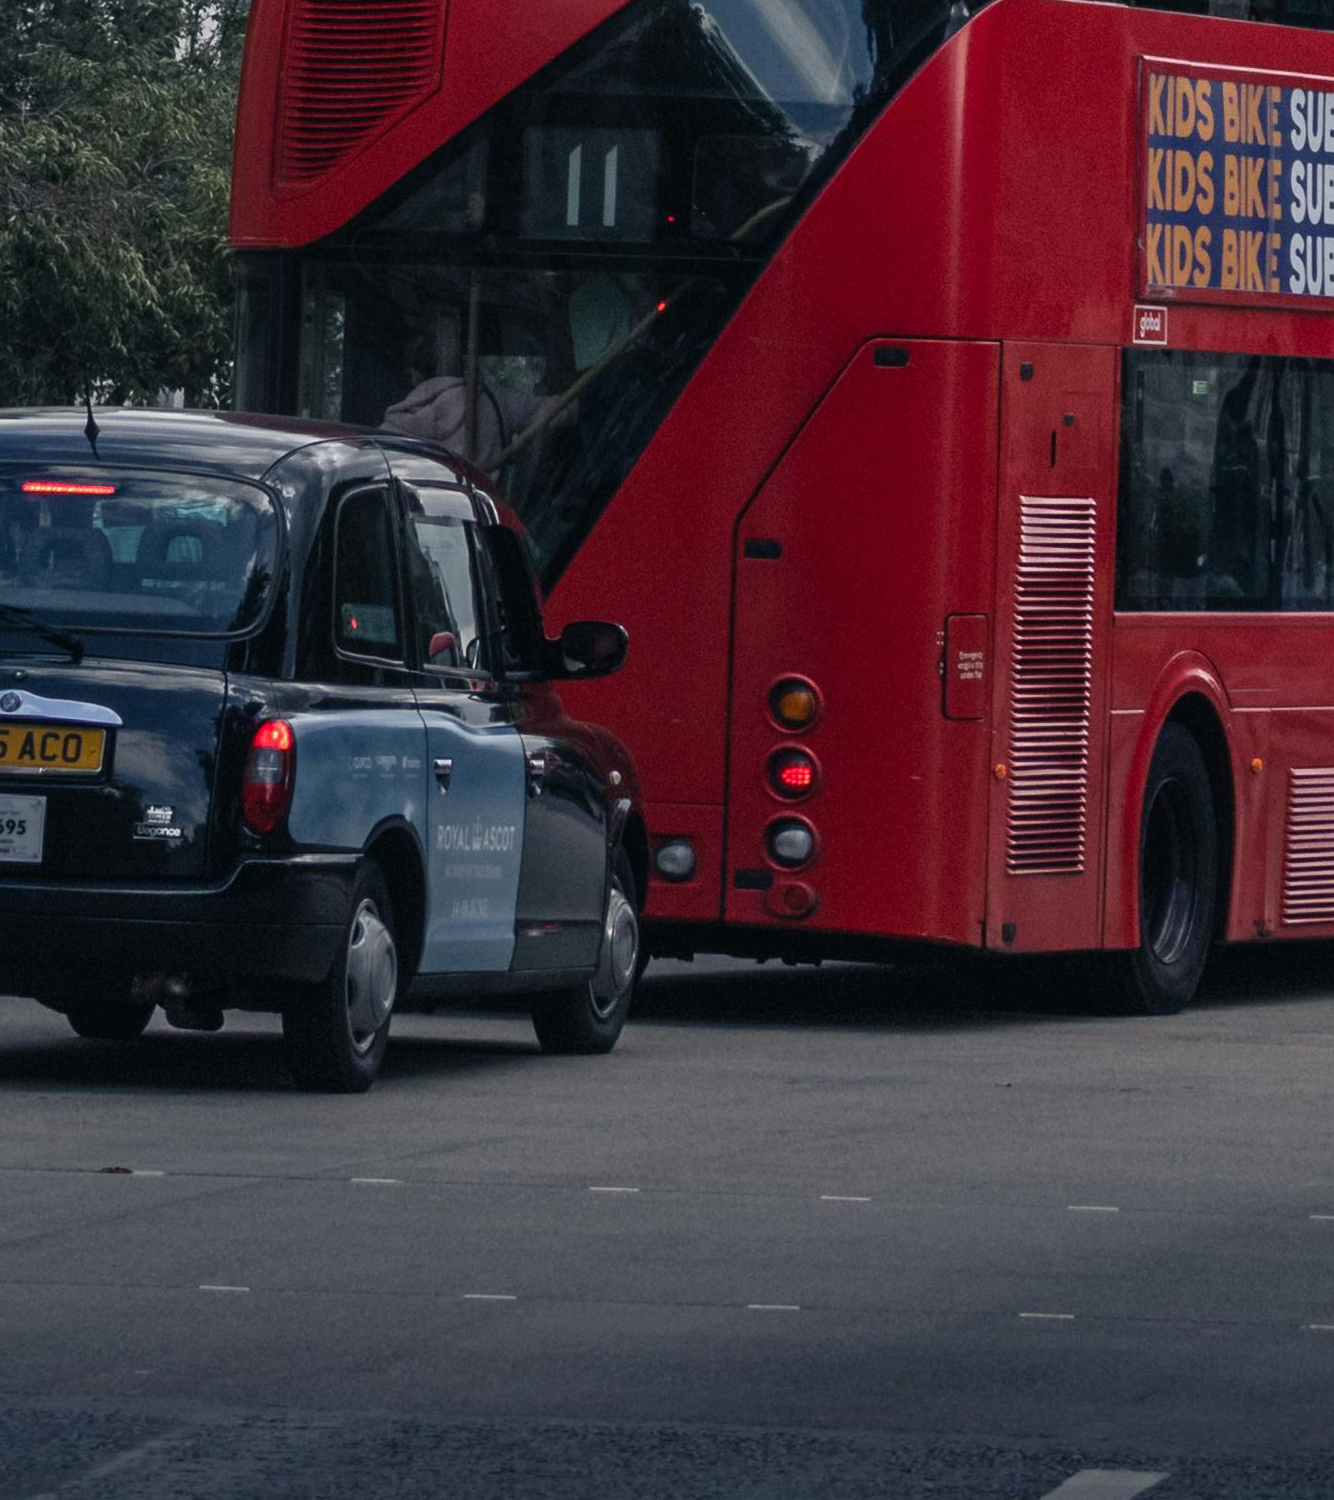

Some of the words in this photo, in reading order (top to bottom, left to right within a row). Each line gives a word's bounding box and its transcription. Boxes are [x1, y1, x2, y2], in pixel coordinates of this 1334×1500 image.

[1148, 73, 1215, 142] KIDS
[1222, 81, 1283, 147] BIKE
[566, 143, 618, 227] 11
[1147, 147, 1215, 215] KIDS
[1223, 154, 1283, 220] BIKE
[1146, 223, 1214, 288] KIDS
[1220, 228, 1283, 293] BIKE
[1139, 311, 1162, 338] global
[17, 731, 83, 764] ACO
[436, 824, 470, 851] ROYAL
[482, 825, 515, 852] ASCOT
